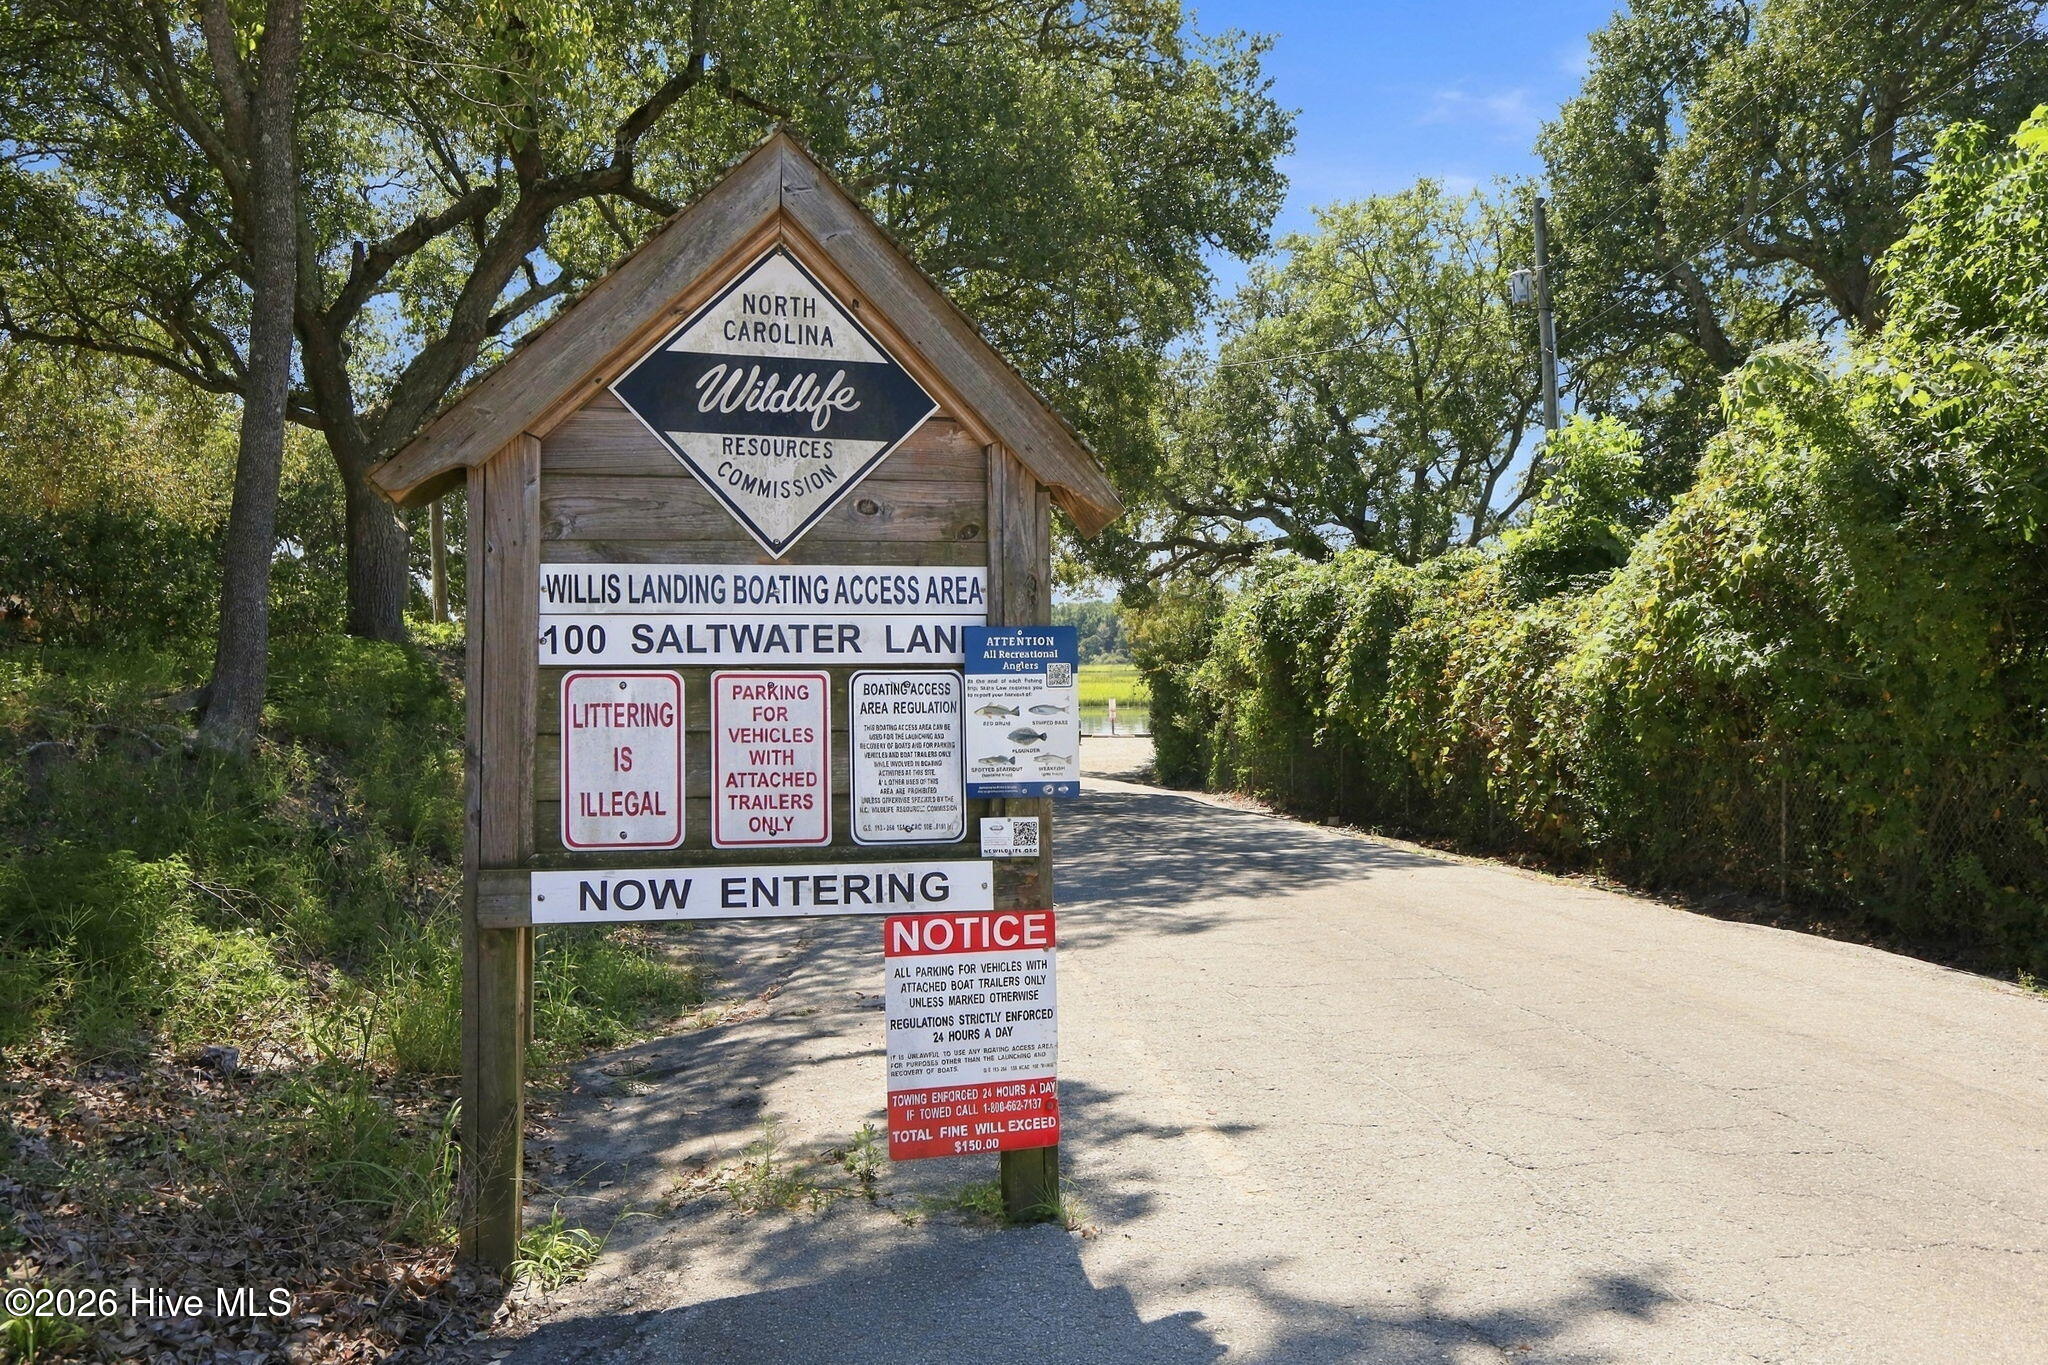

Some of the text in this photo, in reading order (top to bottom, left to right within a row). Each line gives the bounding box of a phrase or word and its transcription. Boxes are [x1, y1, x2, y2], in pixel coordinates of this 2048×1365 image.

[742, 294, 816, 318] NORTH
[723, 321, 833, 347] CAROLINA
[696, 363, 861, 432] Wildlife
[722, 437, 833, 459] RESOURCES
[717, 462, 838, 499] COMMISSION
[546, 574, 983, 605] WILLIS LANDING BOATING ACCESS AREA
[543, 624, 965, 654] 100 SALTWATER LAN
[986, 637, 1054, 646] ATTENTION
[999, 650, 1058, 658] Recreational
[1003, 662, 1039, 671] Anglers
[732, 684, 809, 700] PARKING
[864, 683, 950, 696] BOATING ACCESS
[573, 702, 673, 728] LITTERING
[753, 707, 788, 721] FOR
[860, 701, 957, 714] AREA REGULATION
[728, 728, 814, 743] VEHICLES
[614, 747, 632, 772] IS
[749, 750, 794, 765] WITH
[726, 772, 817, 788] ATTACHED
[580, 791, 666, 817] ILLEGAL
[728, 794, 813, 810] TRAILERS
[749, 817, 794, 832] ONLY
[579, 872, 950, 912] NOW ENTERING
[893, 914, 1047, 953] NOTICE
[894, 960, 1047, 979] ALL PARKING FOR VEHICLES WITH
[901, 975, 1046, 993] ATTACHED BOAT TRAILERS ONLY
[909, 990, 1039, 1008] UNLESS MARKED OTHERWISE
[890, 1009, 1053, 1030] REGULATIONS STRICTLY ENFORCED
[933, 1027, 1014, 1043] 24 HOURS A DAY
[892, 1082, 1056, 1107] TOWING ENFORCED 24 HOURS A DAY
[906, 1110, 915, 1121] IF
[919, 1107, 952, 1120] TOWED
[956, 1105, 978, 1117] CALL
[892, 1117, 1056, 1143] TOTAL FINE WILL EXCEED
[954, 1138, 999, 1152] $150.00
